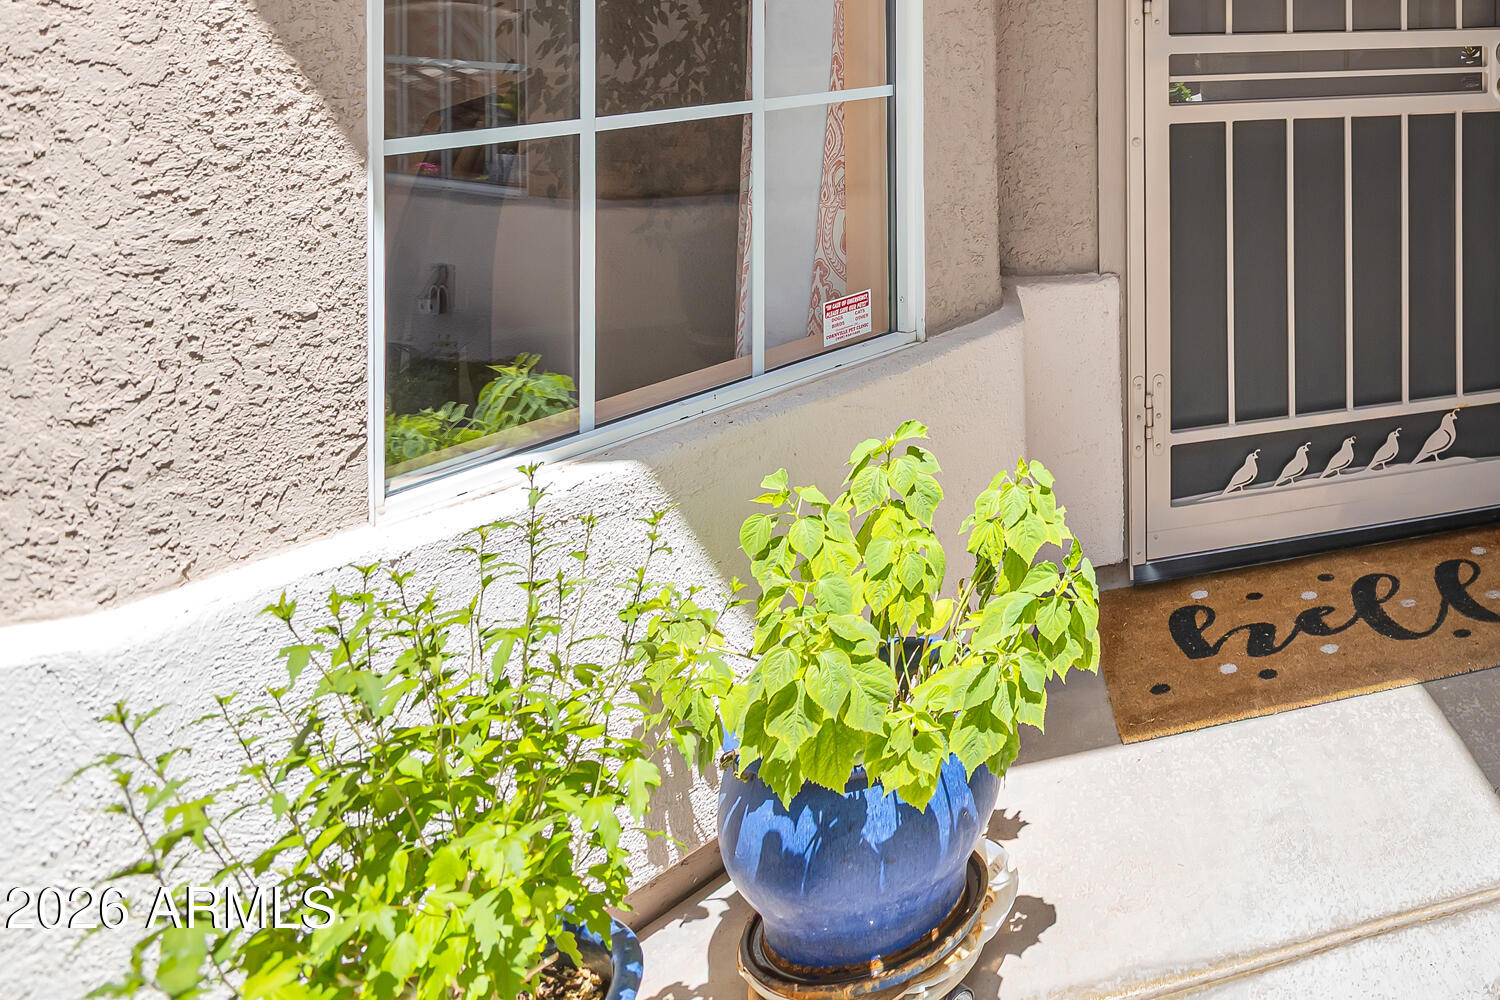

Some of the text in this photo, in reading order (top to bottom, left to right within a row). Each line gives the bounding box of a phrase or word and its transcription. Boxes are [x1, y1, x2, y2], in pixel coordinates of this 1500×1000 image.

[855, 313, 869, 321] OTHER
[832, 321, 845, 329] BIRDS
[856, 322, 869, 330] CLINIC
